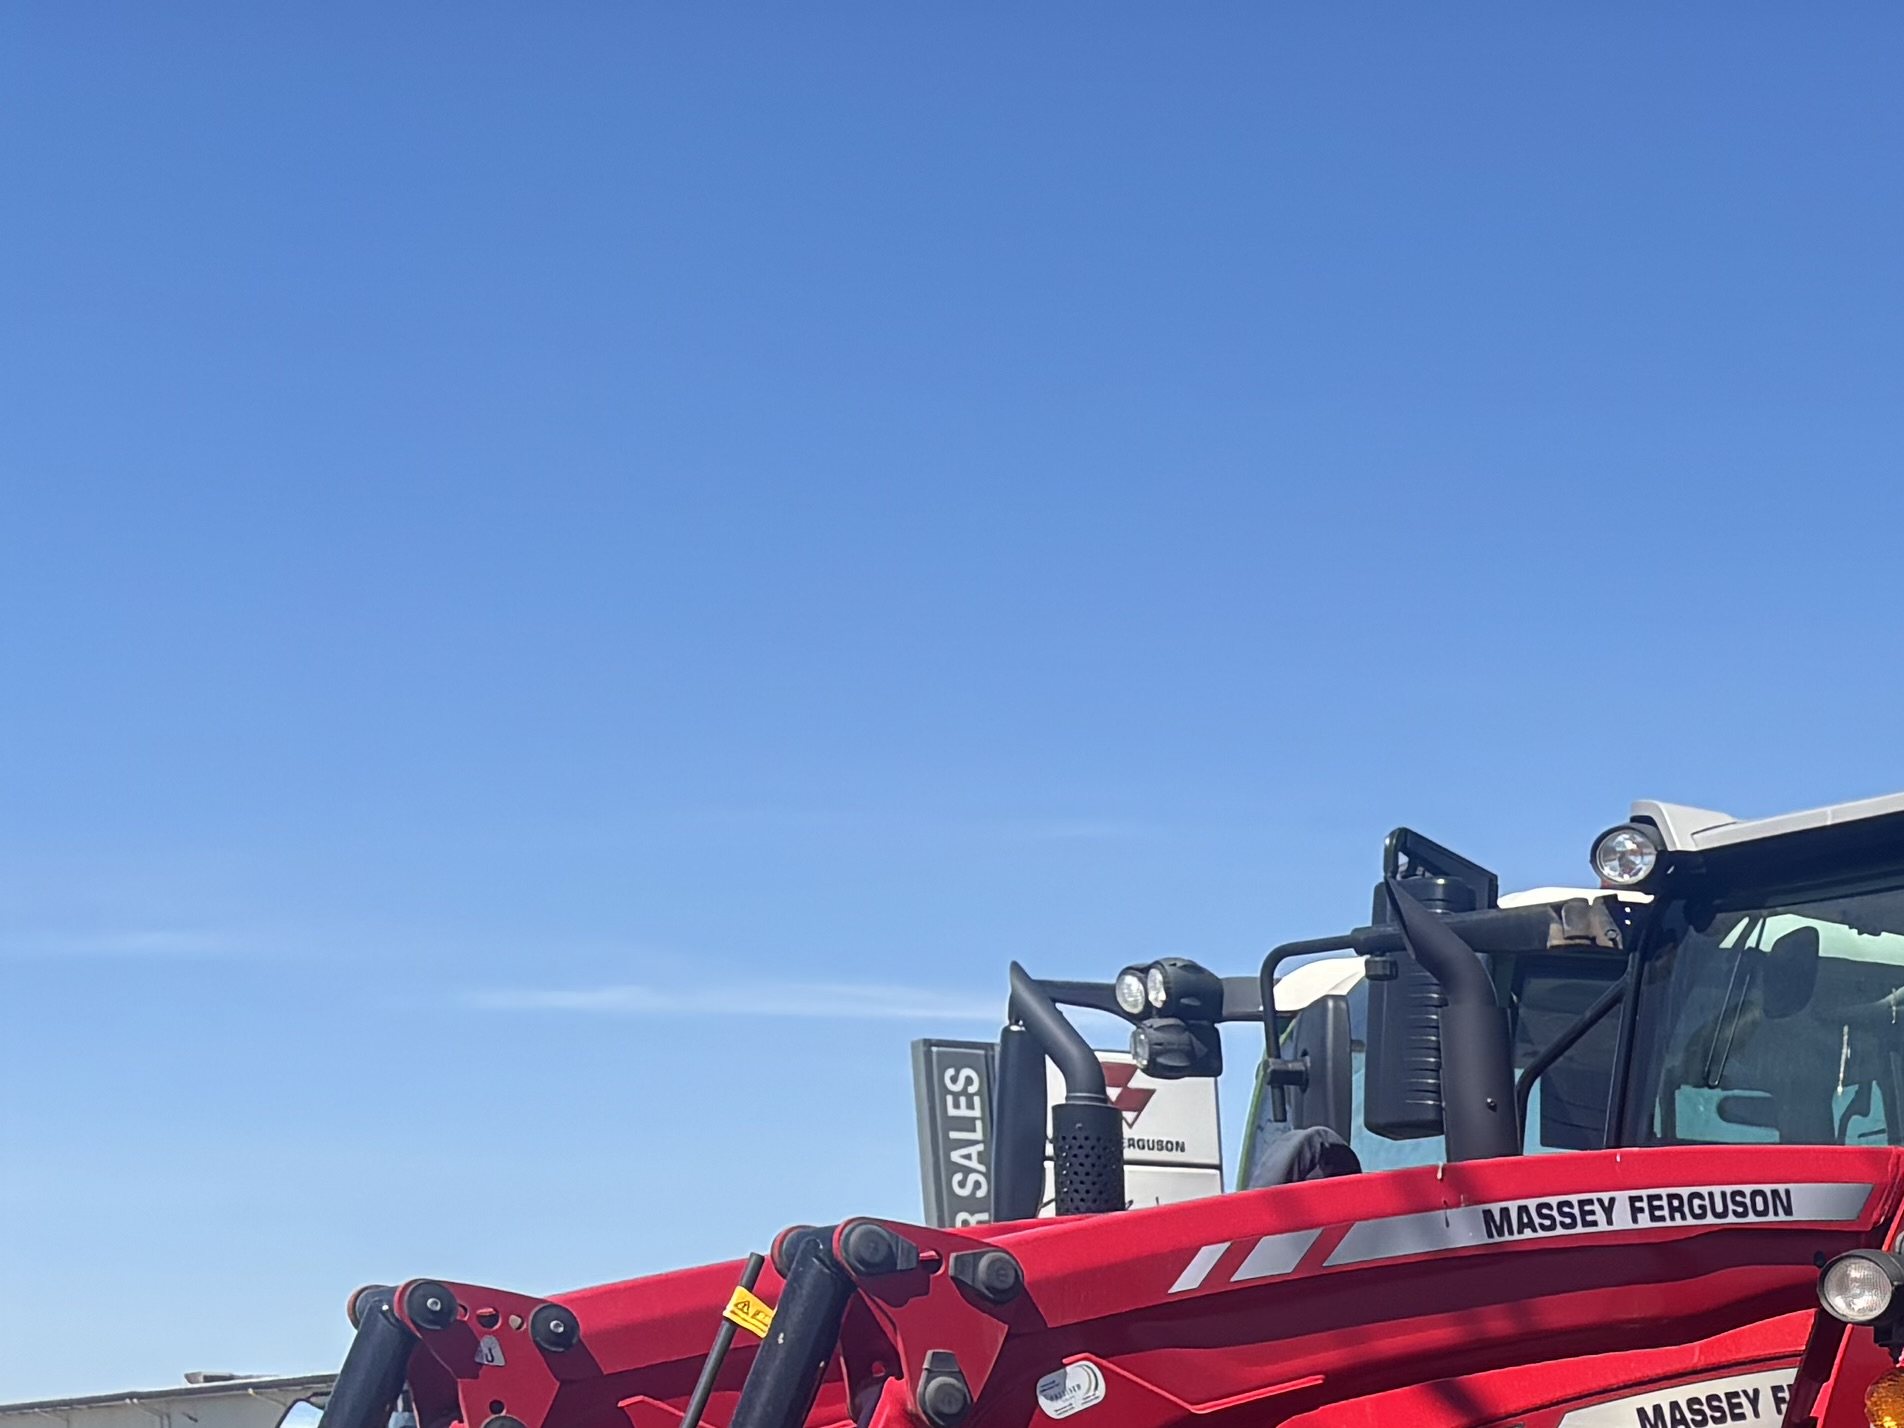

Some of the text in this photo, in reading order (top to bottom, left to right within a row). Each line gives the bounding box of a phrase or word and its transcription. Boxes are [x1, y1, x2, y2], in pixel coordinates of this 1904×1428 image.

[944, 1067, 989, 1198] SALES
[1482, 1188, 1794, 1239] MASSEY FERGUSON
